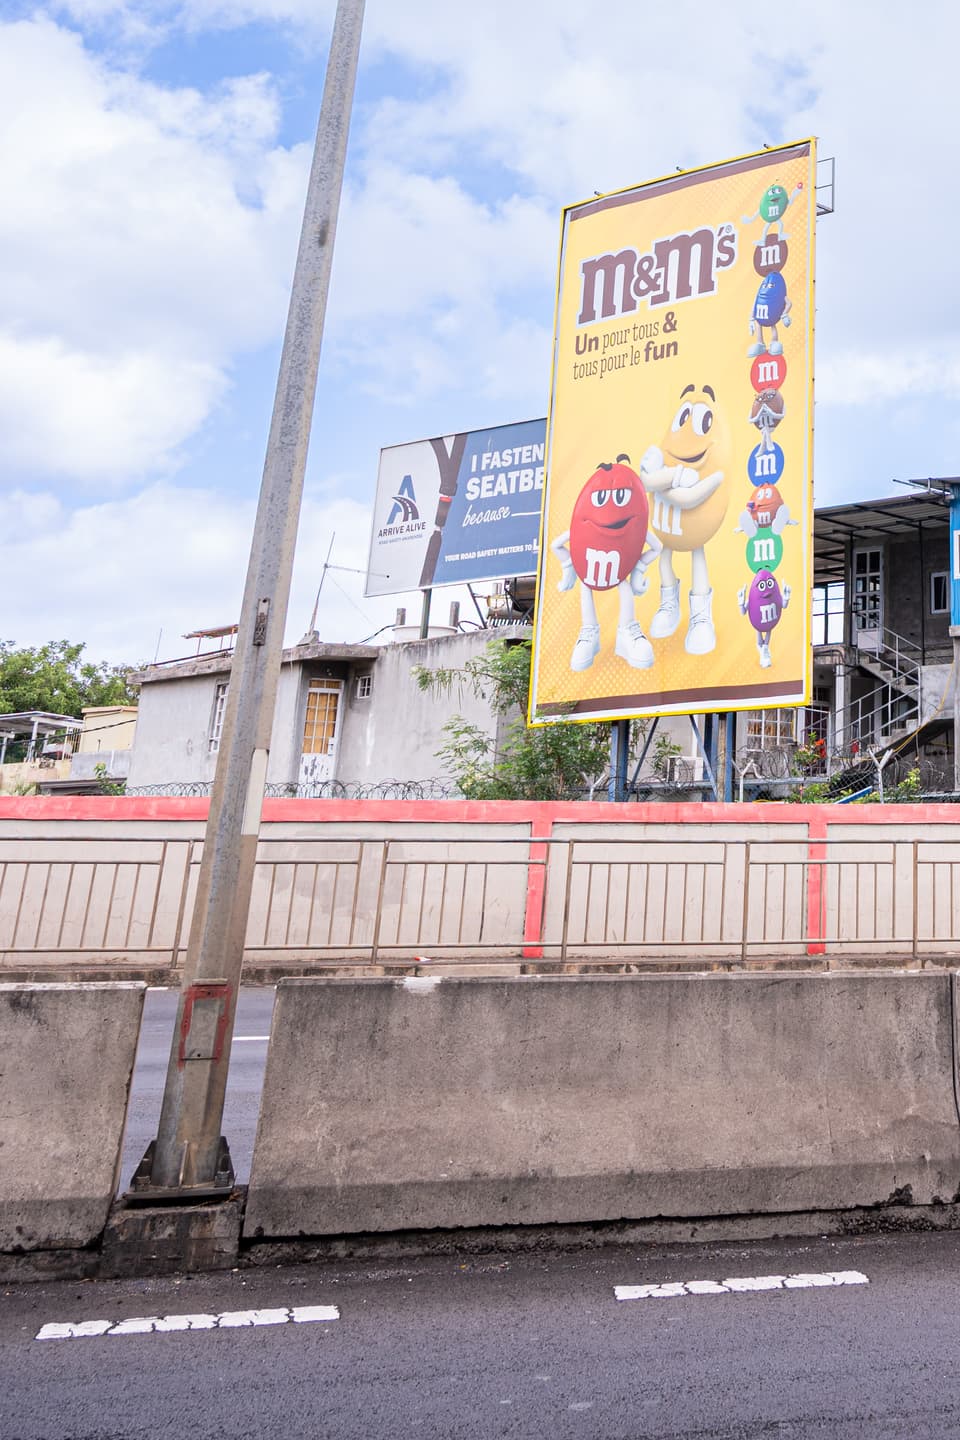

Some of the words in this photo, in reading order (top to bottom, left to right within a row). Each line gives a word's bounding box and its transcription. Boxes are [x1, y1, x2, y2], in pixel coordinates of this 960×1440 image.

[767, 204, 780, 217] m
[760, 243, 781, 268] m
[756, 304, 769, 320] m
[575, 334, 600, 356] Un
[602, 327, 631, 354] pour
[632, 320, 660, 343] tous
[662, 311, 678, 334] &
[572, 358, 599, 380] tous
[599, 351, 629, 380] pour
[630, 342, 641, 366] le
[643, 340, 679, 363] fun
[757, 359, 780, 383] m
[471, 455, 477, 472] I
[481, 443, 545, 471] FASTEN
[754, 452, 777, 477] m
[462, 504, 511, 527] because
[378, 526, 405, 537] ARRIVE
[405, 521, 427, 533] ALIVE
[460, 551, 477, 560] ROAD
[476, 548, 498, 559] SAFETY
[498, 544, 524, 555] MATTERS
[753, 537, 776, 562] m
[583, 547, 621, 587] m
[760, 602, 777, 624] m
